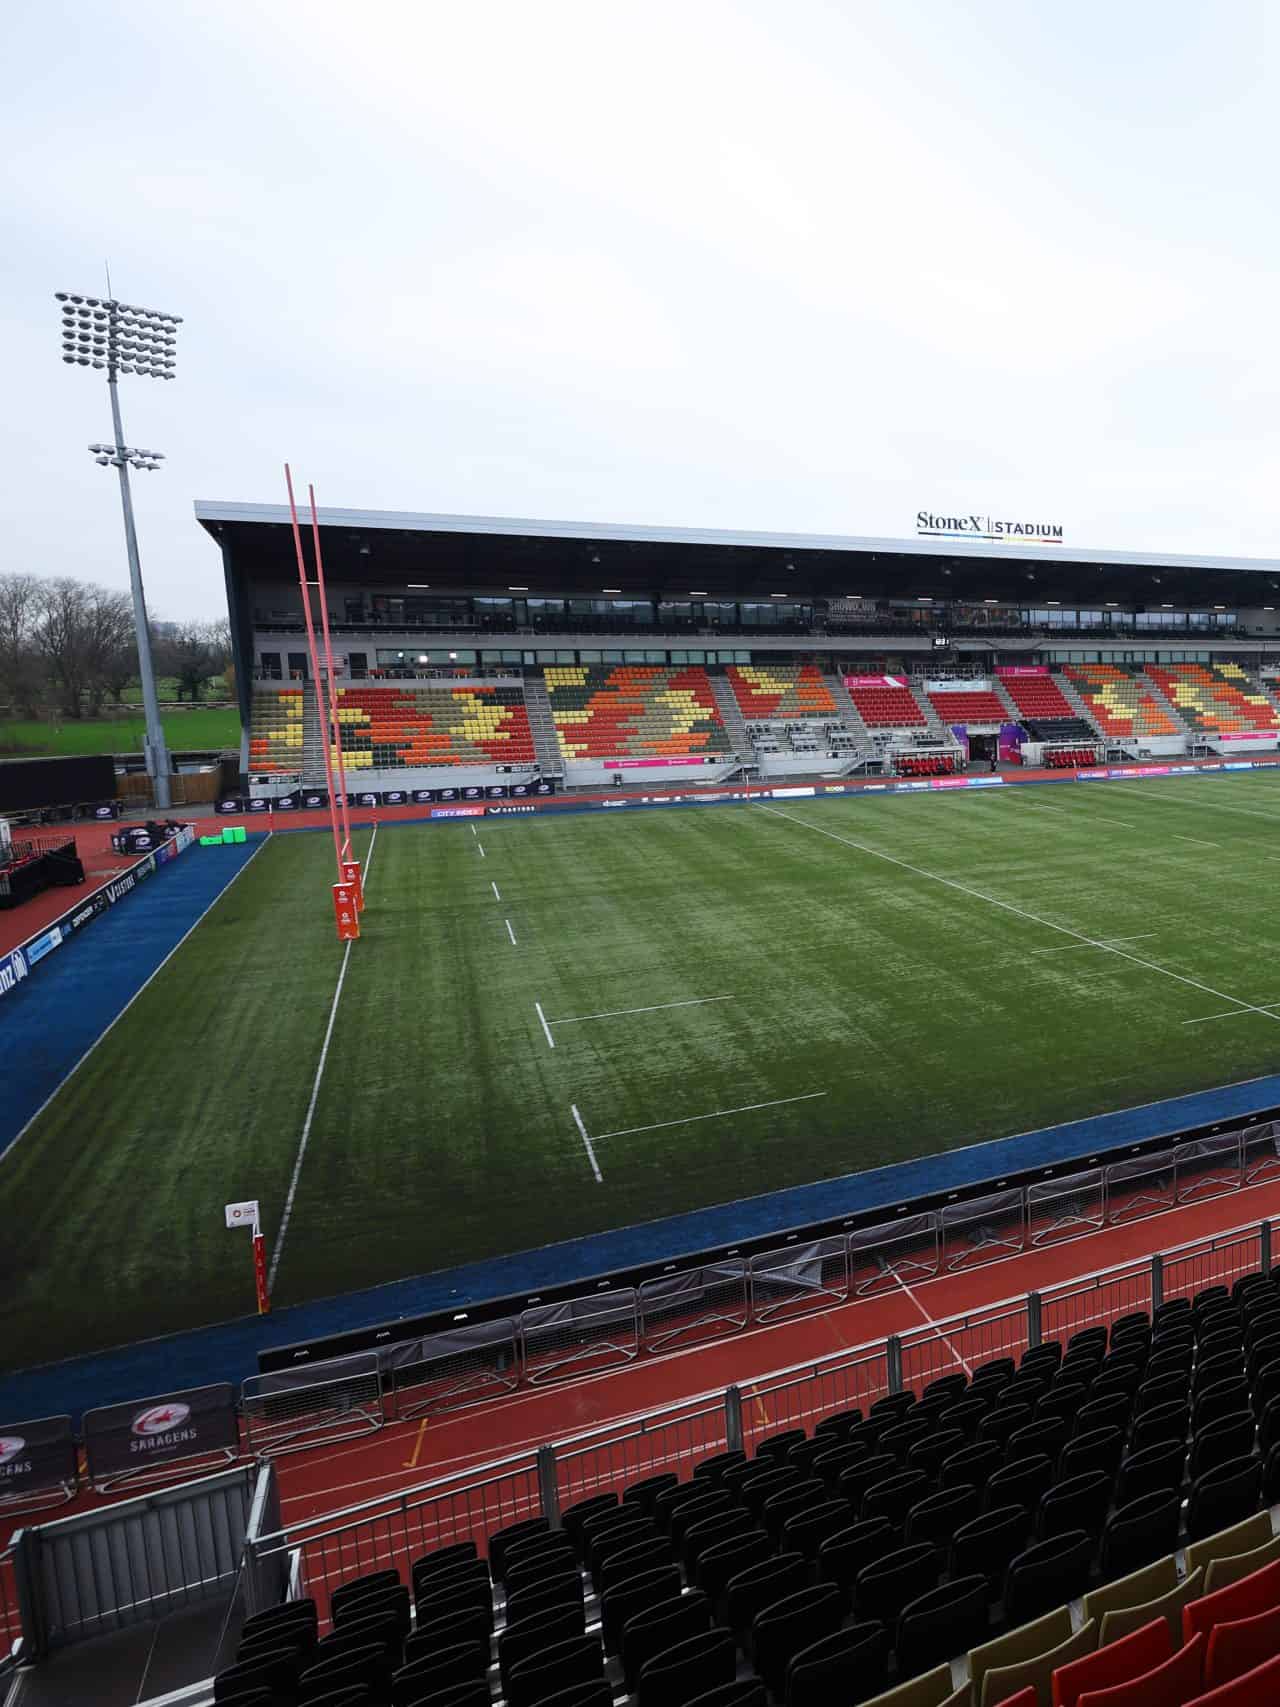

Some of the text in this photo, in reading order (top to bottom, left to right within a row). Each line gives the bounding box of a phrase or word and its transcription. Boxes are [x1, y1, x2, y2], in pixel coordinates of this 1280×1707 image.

[916, 511, 1063, 537] StoneX STADIUM
[130, 1427, 198, 1452] SARACENS
